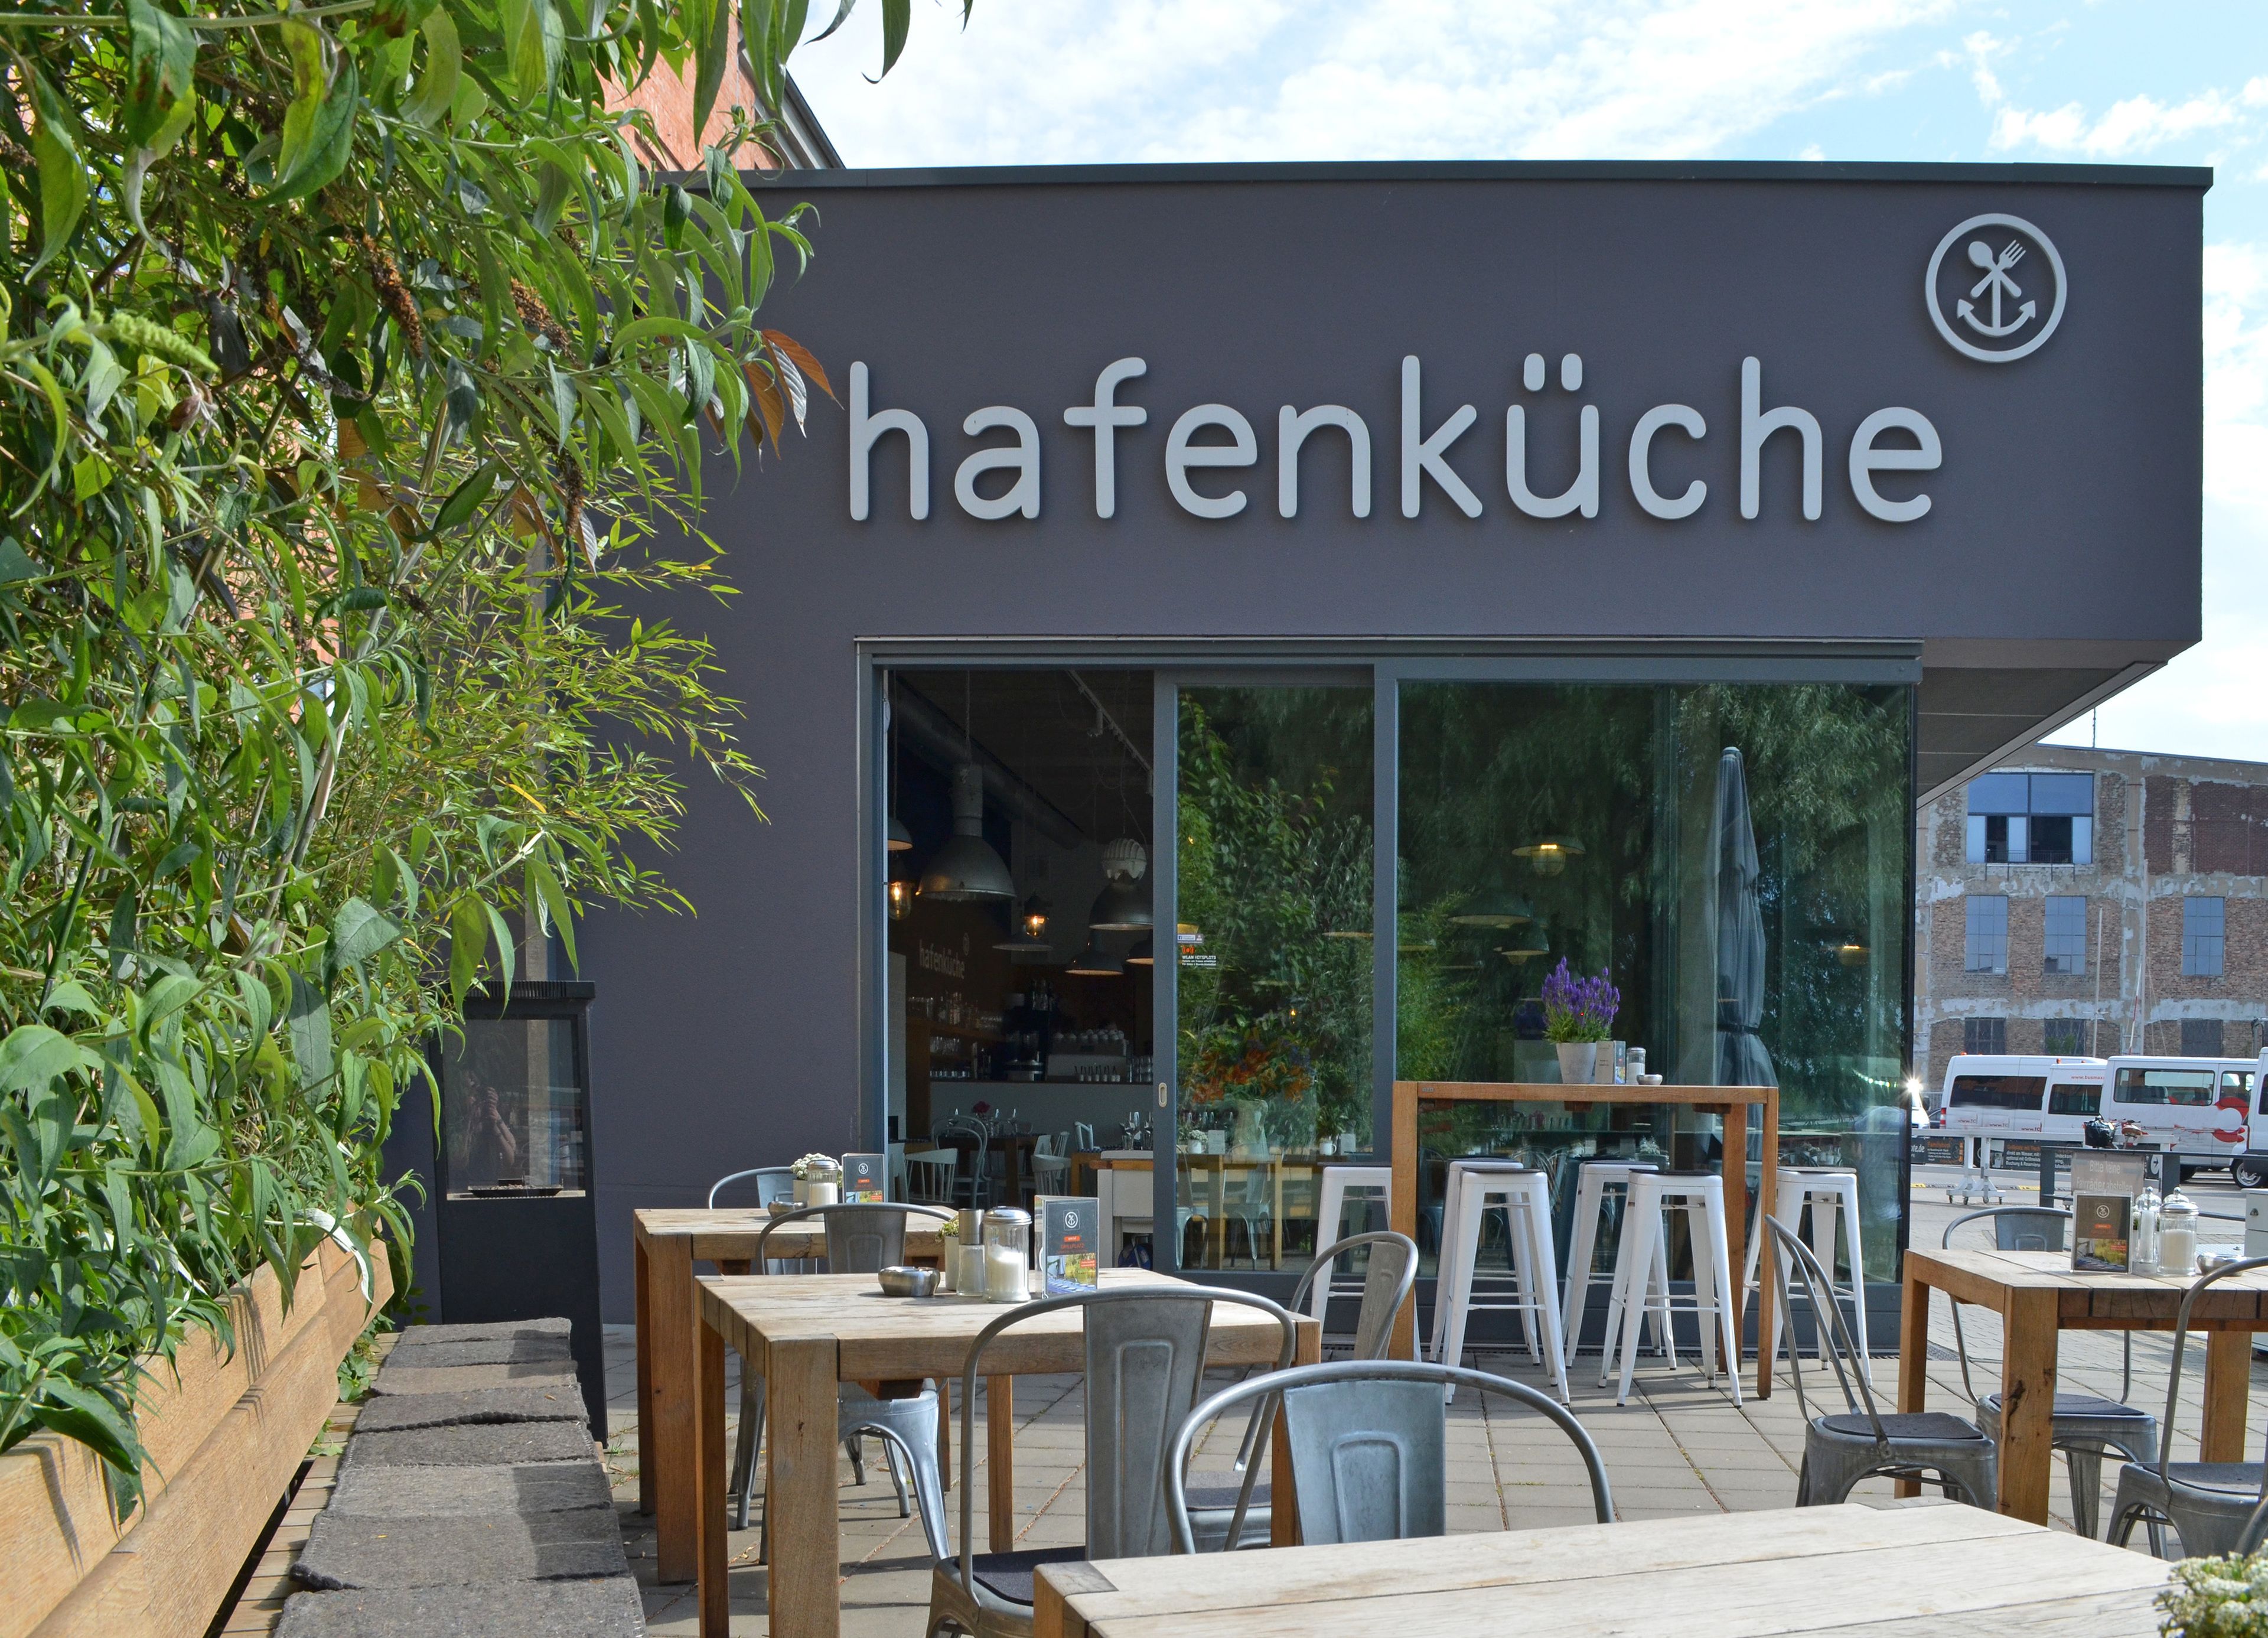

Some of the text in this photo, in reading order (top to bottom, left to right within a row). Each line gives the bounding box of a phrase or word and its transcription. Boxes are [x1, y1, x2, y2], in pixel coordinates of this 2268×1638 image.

[849, 353, 1943, 522] hafenküche
[2089, 1160, 2120, 1174] Bitte keine
